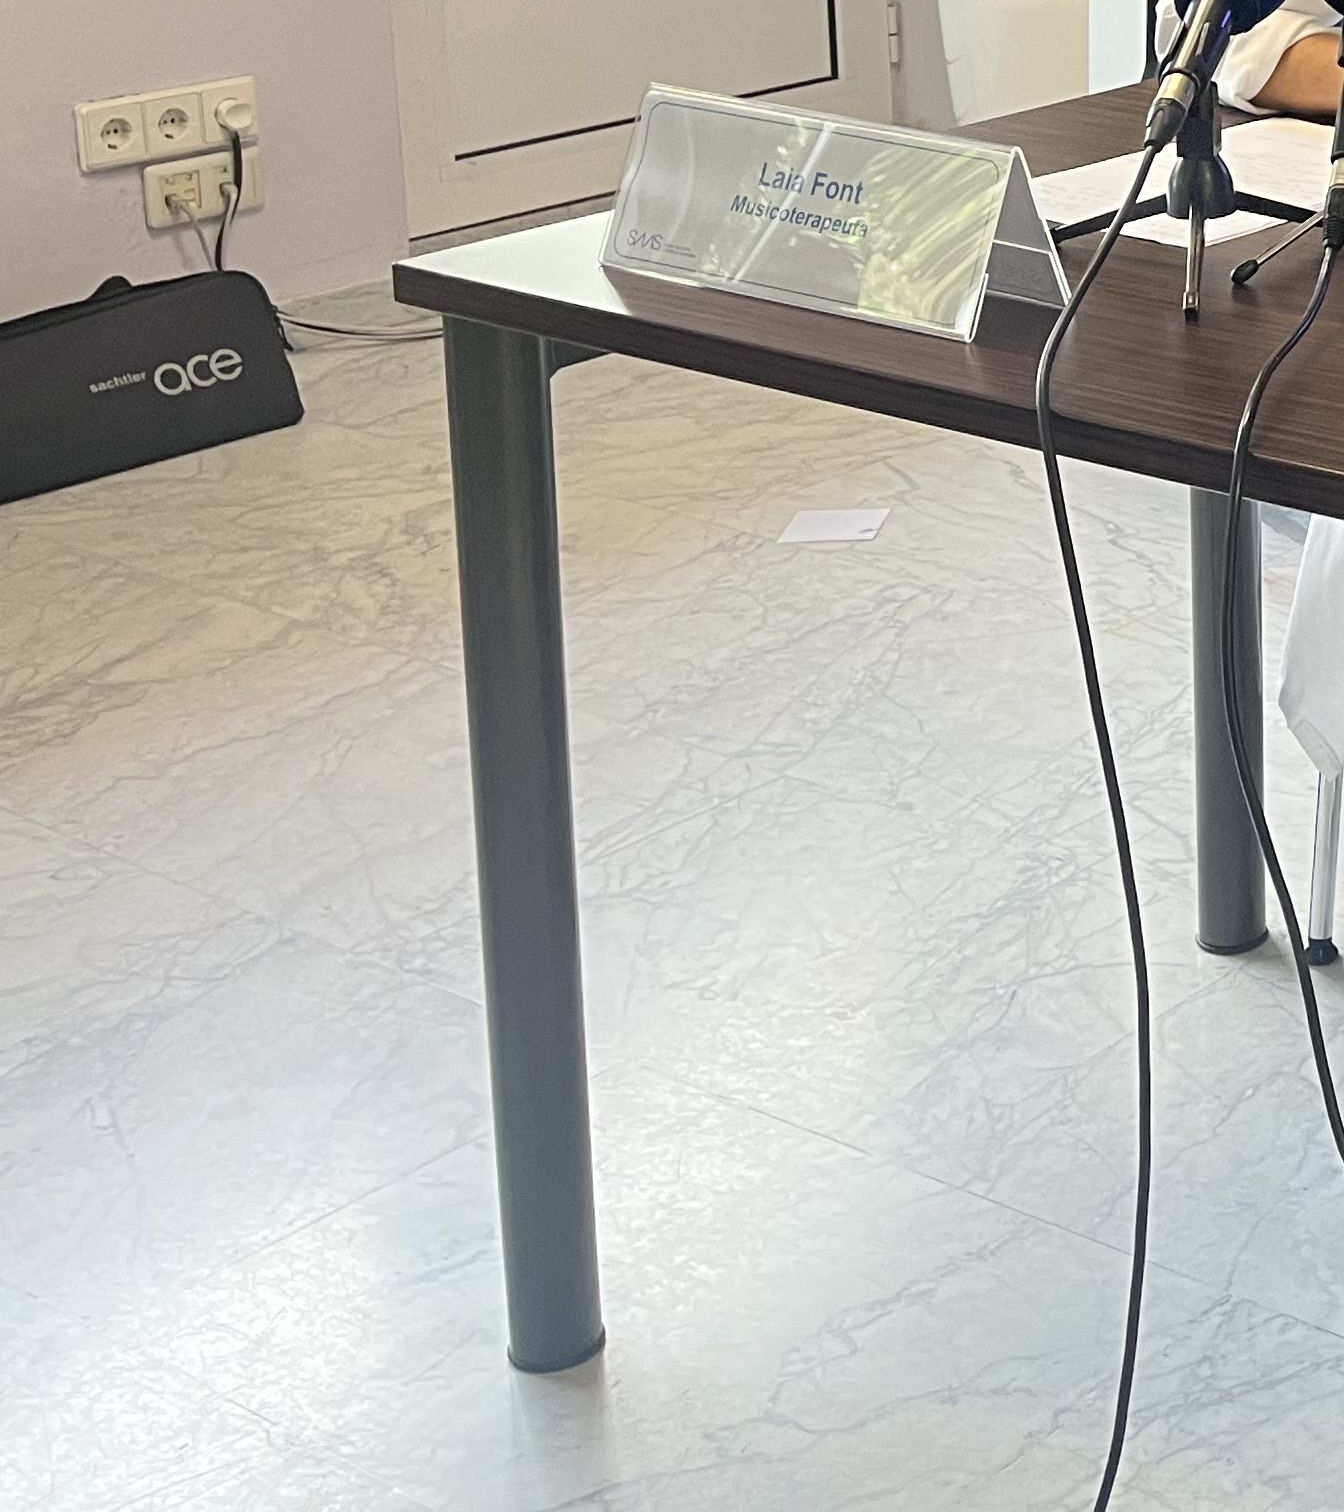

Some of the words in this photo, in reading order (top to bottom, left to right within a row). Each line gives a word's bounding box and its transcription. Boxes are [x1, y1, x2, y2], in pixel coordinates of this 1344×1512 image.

[758, 161, 805, 194] Laia
[810, 171, 864, 205] Font
[729, 194, 869, 238] Musicoterapeuta
[153, 348, 244, 396] ace
